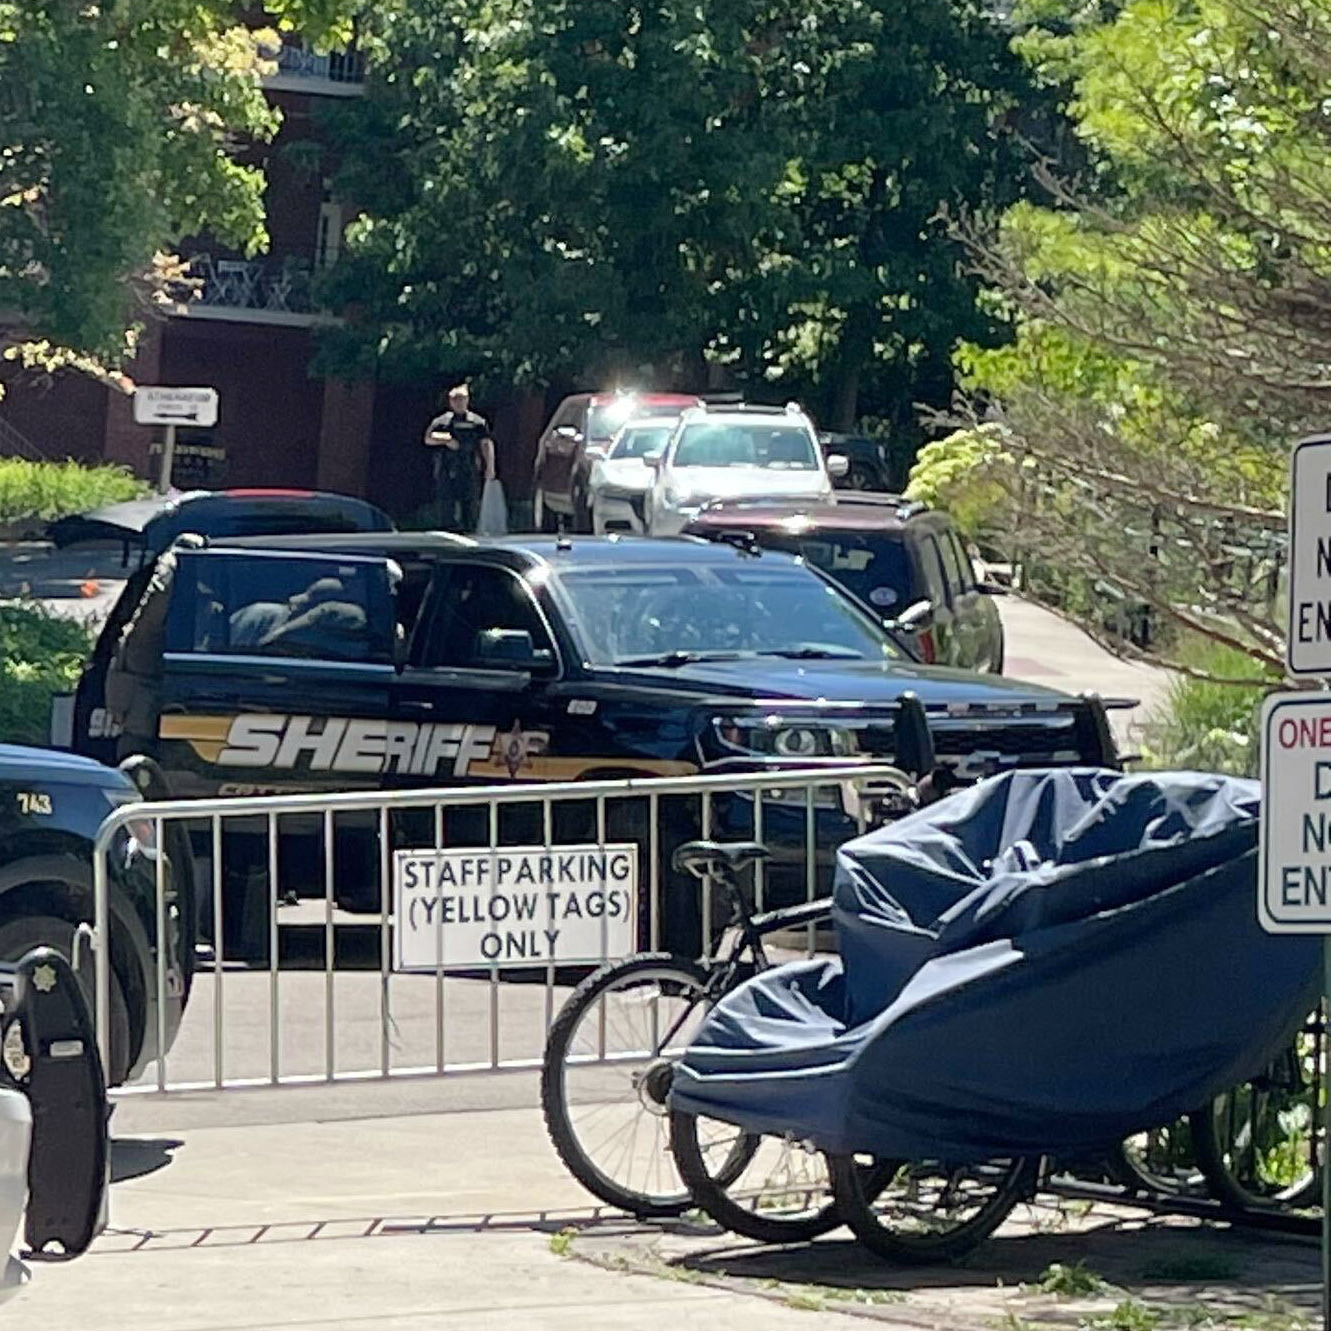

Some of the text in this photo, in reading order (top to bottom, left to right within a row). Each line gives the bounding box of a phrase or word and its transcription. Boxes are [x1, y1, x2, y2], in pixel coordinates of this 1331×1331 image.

[217, 712, 497, 777] SHERIFF
[17, 793, 52, 815] 743
[1303, 813, 1331, 852] N
[404, 855, 630, 888] STAFF PARKING
[1282, 866, 1331, 906] EN
[409, 890, 630, 931] (YELLOW TAGS)
[481, 930, 560, 959] ONLY
